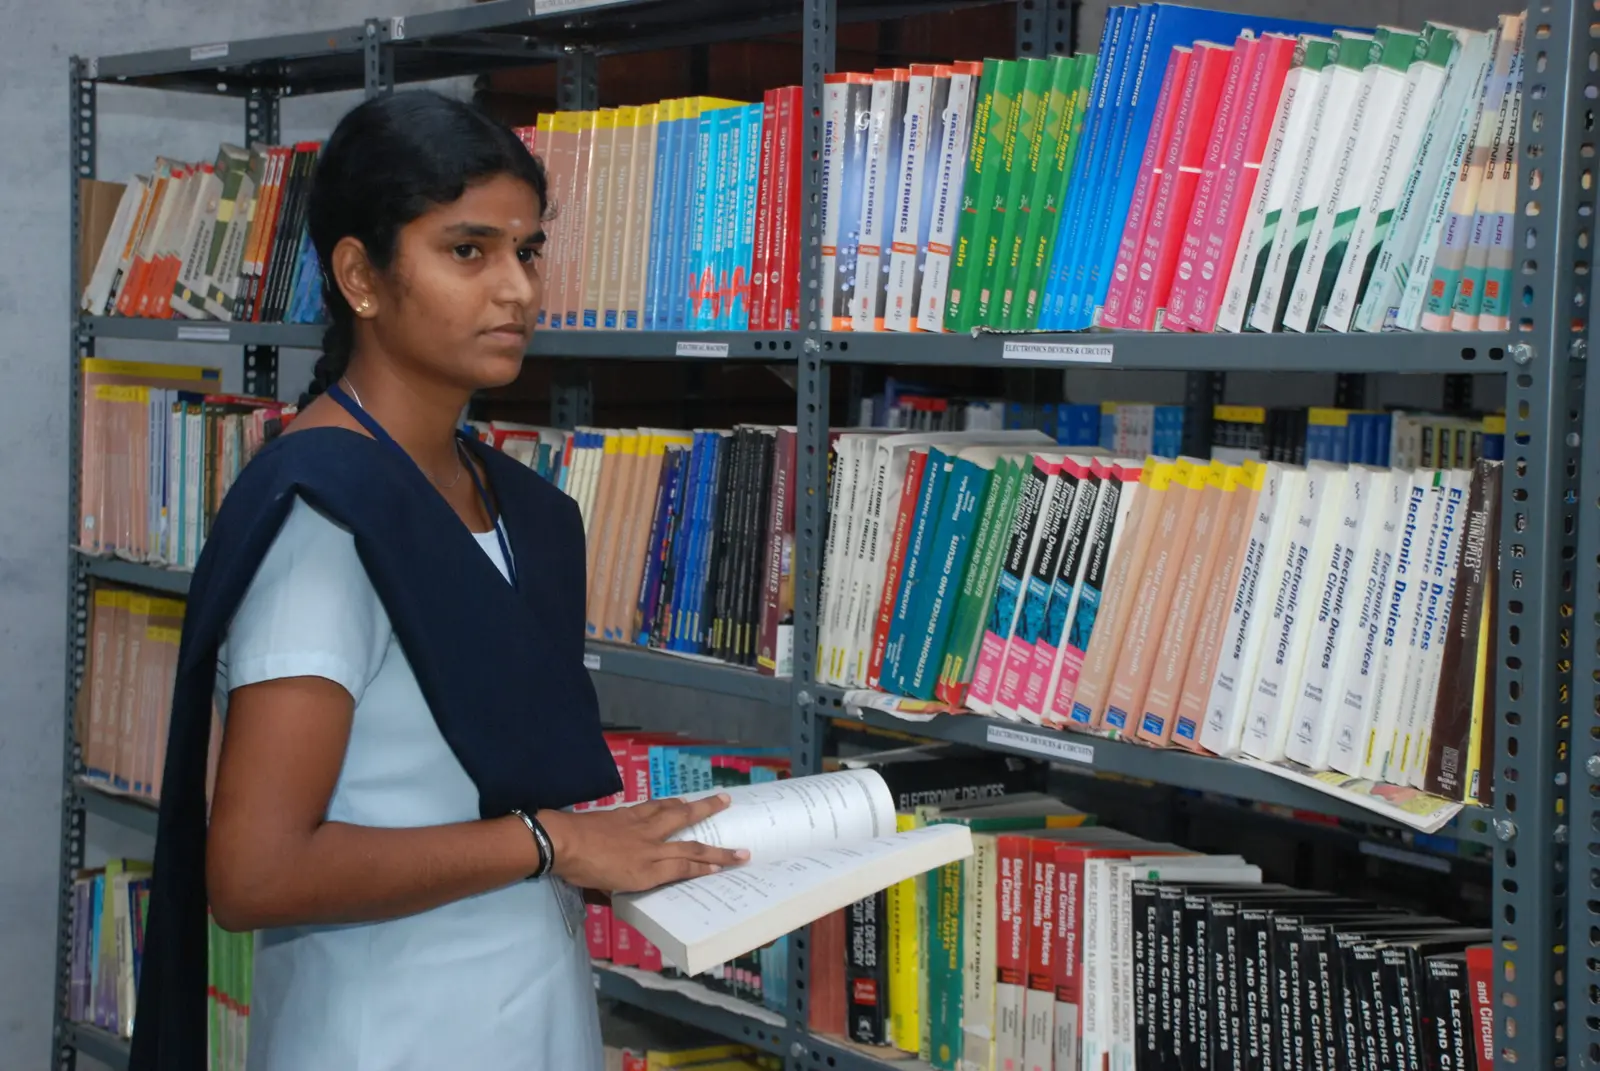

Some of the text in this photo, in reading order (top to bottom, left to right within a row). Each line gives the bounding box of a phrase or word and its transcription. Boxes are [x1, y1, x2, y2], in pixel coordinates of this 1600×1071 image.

[1131, 14, 1156, 106] BASIC ELECTRONICS
[824, 121, 833, 156] BASIC
[975, 94, 992, 173] Modern Digital
[1006, 92, 1022, 172] Modern Digital
[1032, 92, 1049, 171] Modern Digital
[1058, 90, 1077, 171] Modern Digital
[1153, 60, 1198, 228] COMMUNICATION SYSTEMS
[1194, 56, 1241, 226] COMMUNICATION SYSTEMS
[1216, 53, 1266, 226] COMMUNICATION SYSTEMS
[1257, 88, 1296, 215] Digital Electronics
[1327, 84, 1371, 216] Digital Electronics
[1369, 82, 1416, 214] Digital Electronics
[1460, 82, 1487, 182] ELECTRONICS
[1487, 82, 1512, 179] ELECTRONICS
[1503, 82, 1522, 180] ELECTRONICS
[865, 158, 876, 235] ELECTRONICS
[900, 114, 918, 233] BASIC ELECTRONICS
[936, 113, 958, 233] BASIC ELECTRONICS
[1400, 133, 1433, 221] Digital Electronics
[1436, 134, 1467, 223] Digital Electronics
[758, 210, 766, 258] Systems
[957, 236, 968, 267] Jain
[987, 236, 997, 266] Jain
[1011, 236, 1021, 266] Jain
[1036, 236, 1046, 266] Jain
[1446, 217, 1457, 245] PURI
[1474, 215, 1484, 243] PURI
[1495, 216, 1505, 244] PURI
[1005, 344, 1046, 353] ELECTRONICS
[1048, 346, 1074, 354] DEVICES
[1081, 348, 1111, 356] CIRCUITS
[775, 470, 785, 535] ELECTRICAL
[870, 466, 885, 562] ELECTRONIC CIRCUITS
[890, 513, 906, 562] Electronic
[900, 462, 937, 620] ELECTRONIC DEVICES AND CIRCUITS
[962, 473, 1002, 595] ELECTRONIC DEVICES AND CIRCUITS
[1011, 478, 1041, 571] Electronic Devices
[1039, 482, 1070, 575] Electronic Devices
[1064, 483, 1094, 577] Electronic Devices
[1090, 486, 1115, 581] Electronic Devices
[1464, 511, 1482, 568] PRINCIPLES
[770, 537, 781, 593] MACHINES
[1234, 538, 1256, 614] and Circuits
[1245, 543, 1264, 608] Electronic
[1274, 542, 1296, 619] and Circuits
[1287, 546, 1308, 612] Electronic
[1334, 548, 1354, 617] Electronic
[1384, 486, 1424, 647] Electronic Devices
[1420, 488, 1462, 650] Electronic Devices
[1474, 502, 1493, 584] Electronic
[885, 567, 897, 606] Circuits
[914, 536, 959, 688] ELECTRONIC DEVICES AND CIRCUITS
[1319, 544, 1342, 623] and Circuits
[1359, 548, 1381, 629] and Circuits
[1361, 552, 1391, 676] Electronic Devices
[1234, 609, 1250, 660] Devices
[1276, 614, 1294, 665] Devices
[1322, 618, 1339, 669] Devices
[636, 770, 647, 800] ANTE
[962, 784, 1004, 800] DEVICES
[948, 861, 958, 969] CTRONIC DEVICES
[1002, 858, 1012, 921] and Circuits
[1033, 862, 1043, 926] and Circuits
[1059, 893, 1068, 937] Circuits
[1090, 865, 1098, 894] BASIC
[852, 902, 864, 966] CUIT THEORY
[864, 925, 875, 966] DEVICES
[1088, 895, 1097, 950] ELECTRONICS
[1136, 962, 1144, 1025] CIRCUITS
[1148, 906, 1156, 1050] ELECTRONIC DEVICES
[1173, 910, 1181, 1056] ELECTRONIC DEVICES
[1187, 946, 1196, 1043] AND CIRCUITS
[1197, 920, 1207, 1068] ELECTRONIC DEVICES
[1216, 953, 1228, 1050] AND CIRCUITS
[1227, 927, 1240, 1071] ELECTRONIC DEVICE
[1246, 958, 1258, 1057] AND CIRCUITS
[1290, 943, 1301, 1030] ELECTRONIC
[1308, 980, 1318, 1010] AND
[1319, 952, 1333, 1041] ELECTRONIC
[1361, 1000, 1371, 1030] AND
[1372, 972, 1389, 1063] ELECTRONIC
[1279, 969, 1291, 1070] AND CIRCUITS
[1343, 988, 1356, 1071] AND CIRCU
[1390, 1006, 1400, 1037] AND
[1400, 977, 1417, 1070] ELECTRONIC
[1437, 1017, 1447, 1049] AND
